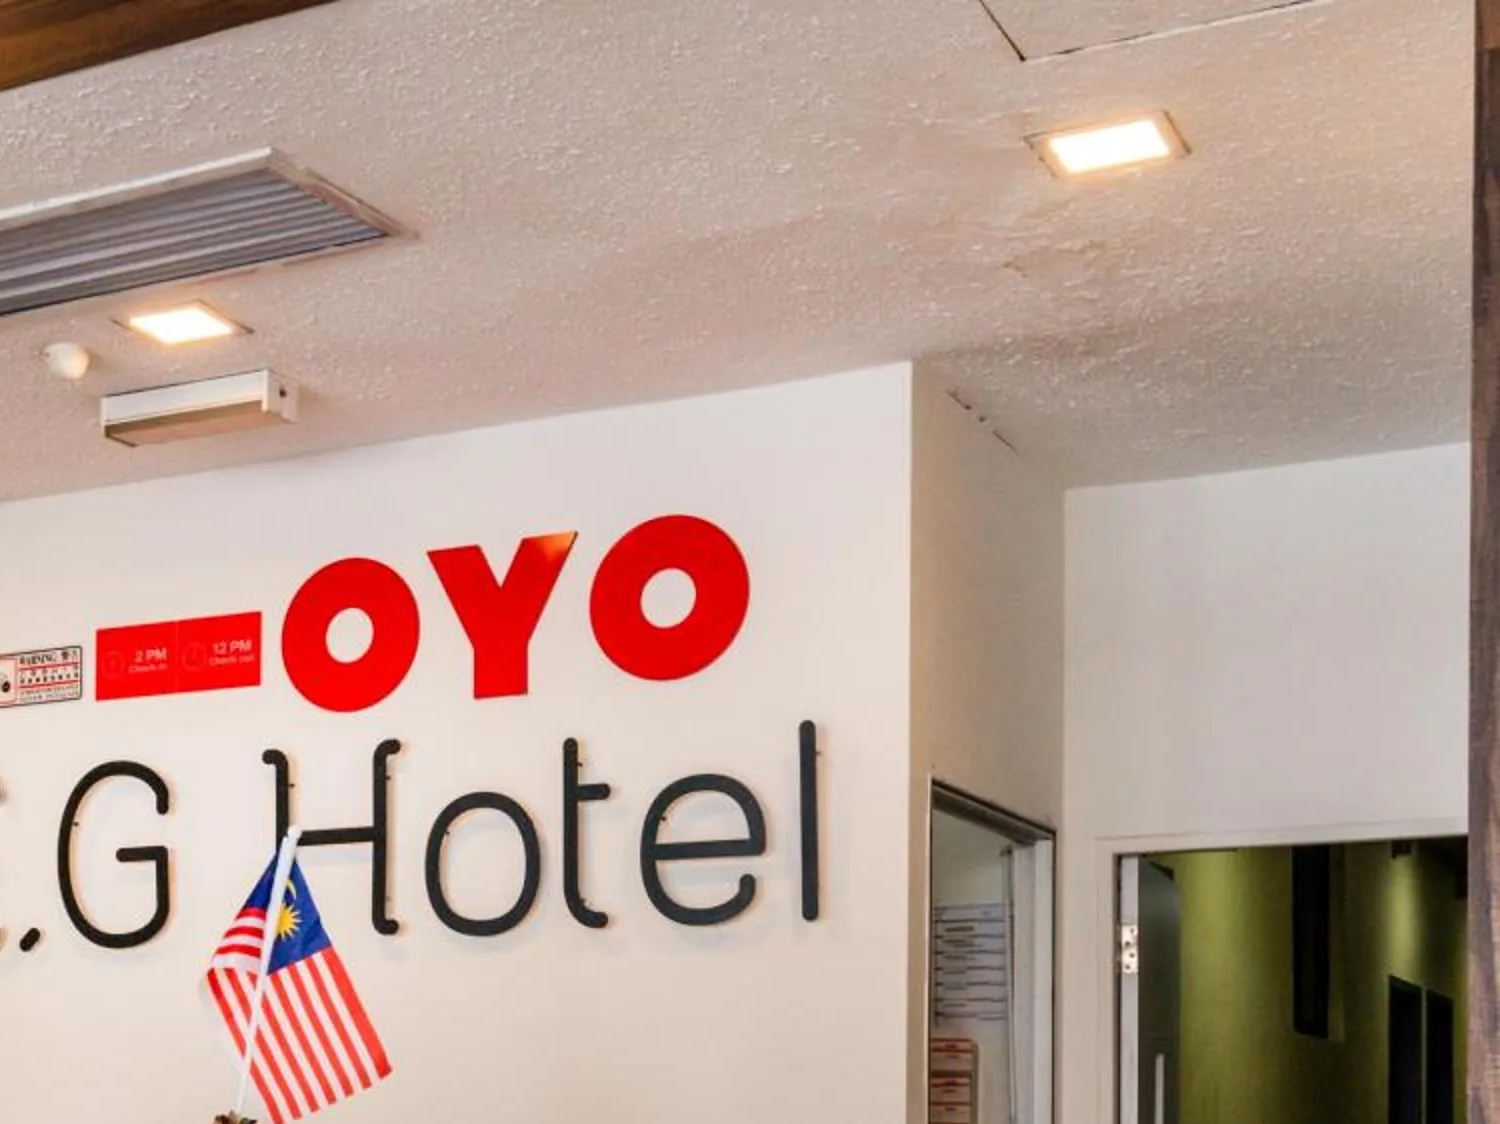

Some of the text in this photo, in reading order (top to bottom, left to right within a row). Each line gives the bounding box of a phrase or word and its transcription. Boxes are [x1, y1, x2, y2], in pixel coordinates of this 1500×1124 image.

[135, 648, 167, 662] 2 PM
[212, 640, 252, 654] 12 PM
[281, 514, 750, 712] OYO
[262, 719, 819, 937] Hotel
